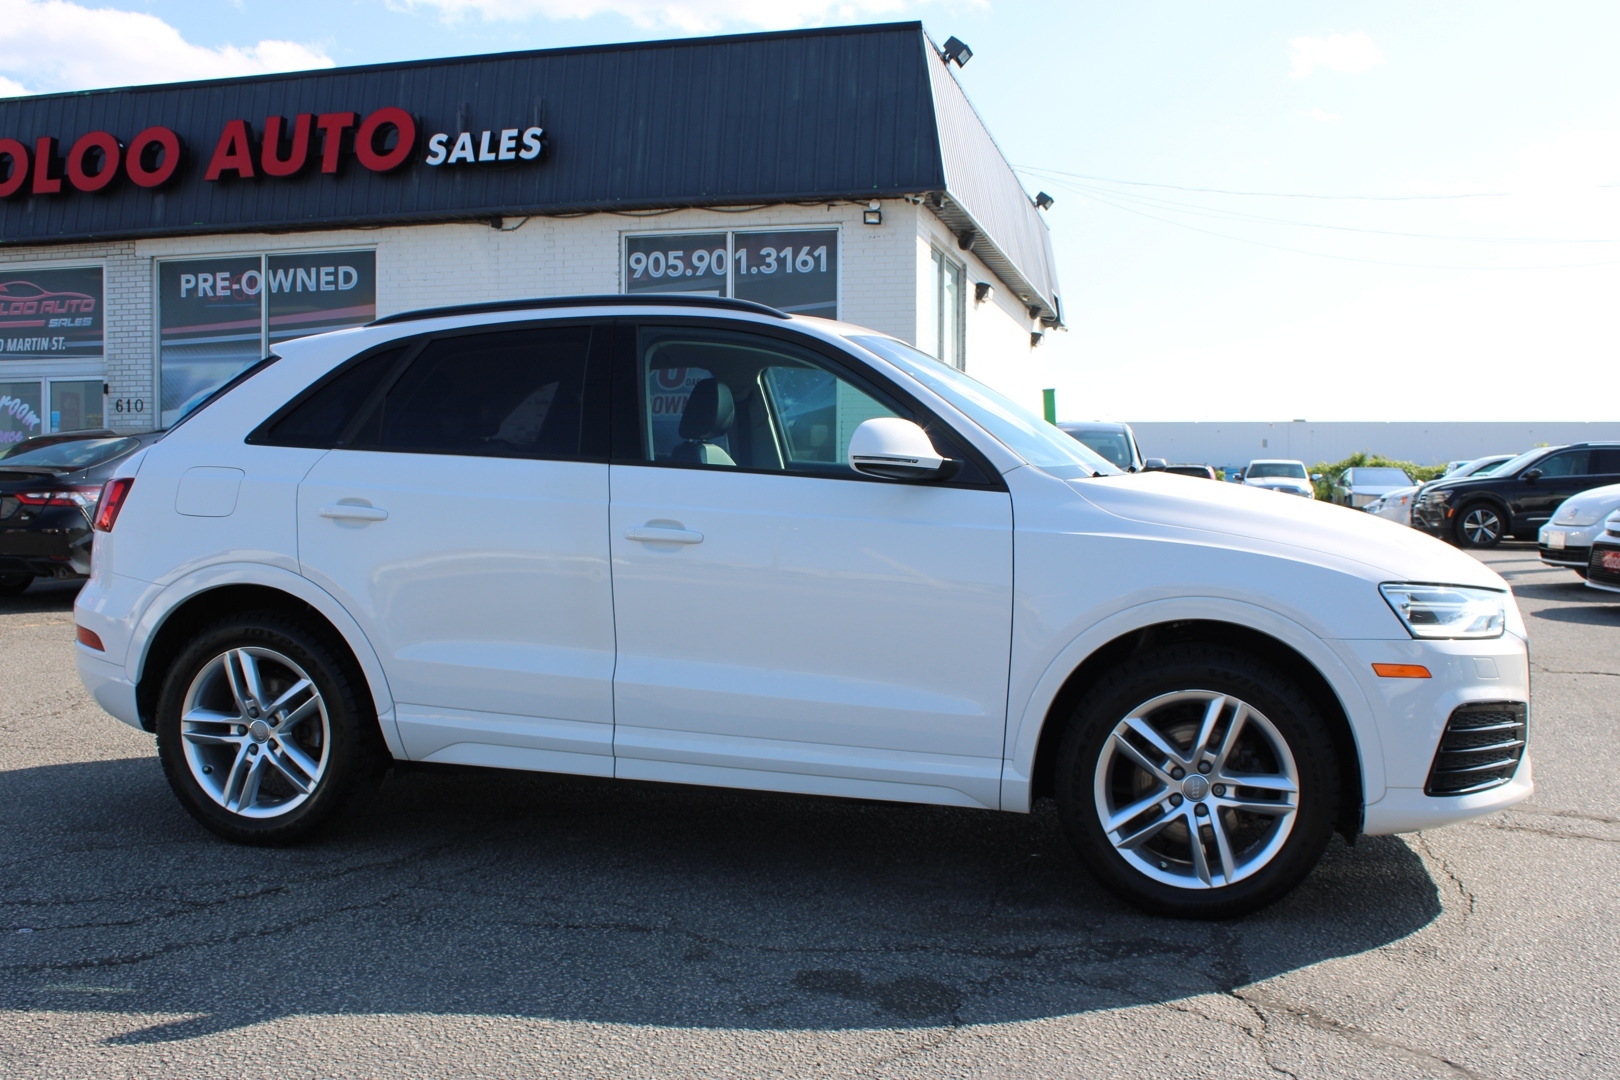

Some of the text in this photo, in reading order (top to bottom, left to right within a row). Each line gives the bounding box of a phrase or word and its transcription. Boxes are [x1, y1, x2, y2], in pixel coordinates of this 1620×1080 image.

[204, 106, 416, 181] AUTO
[425, 127, 543, 166] SALES
[629, 246, 828, 279] 905.901.3161
[180, 266, 358, 298] PRE-OWNED
[39, 300, 96, 314] AUTO
[48, 317, 93, 328] SALES
[6, 337, 49, 352] MARTIN
[51, 337, 66, 350] ST.
[115, 399, 144, 412] 610
